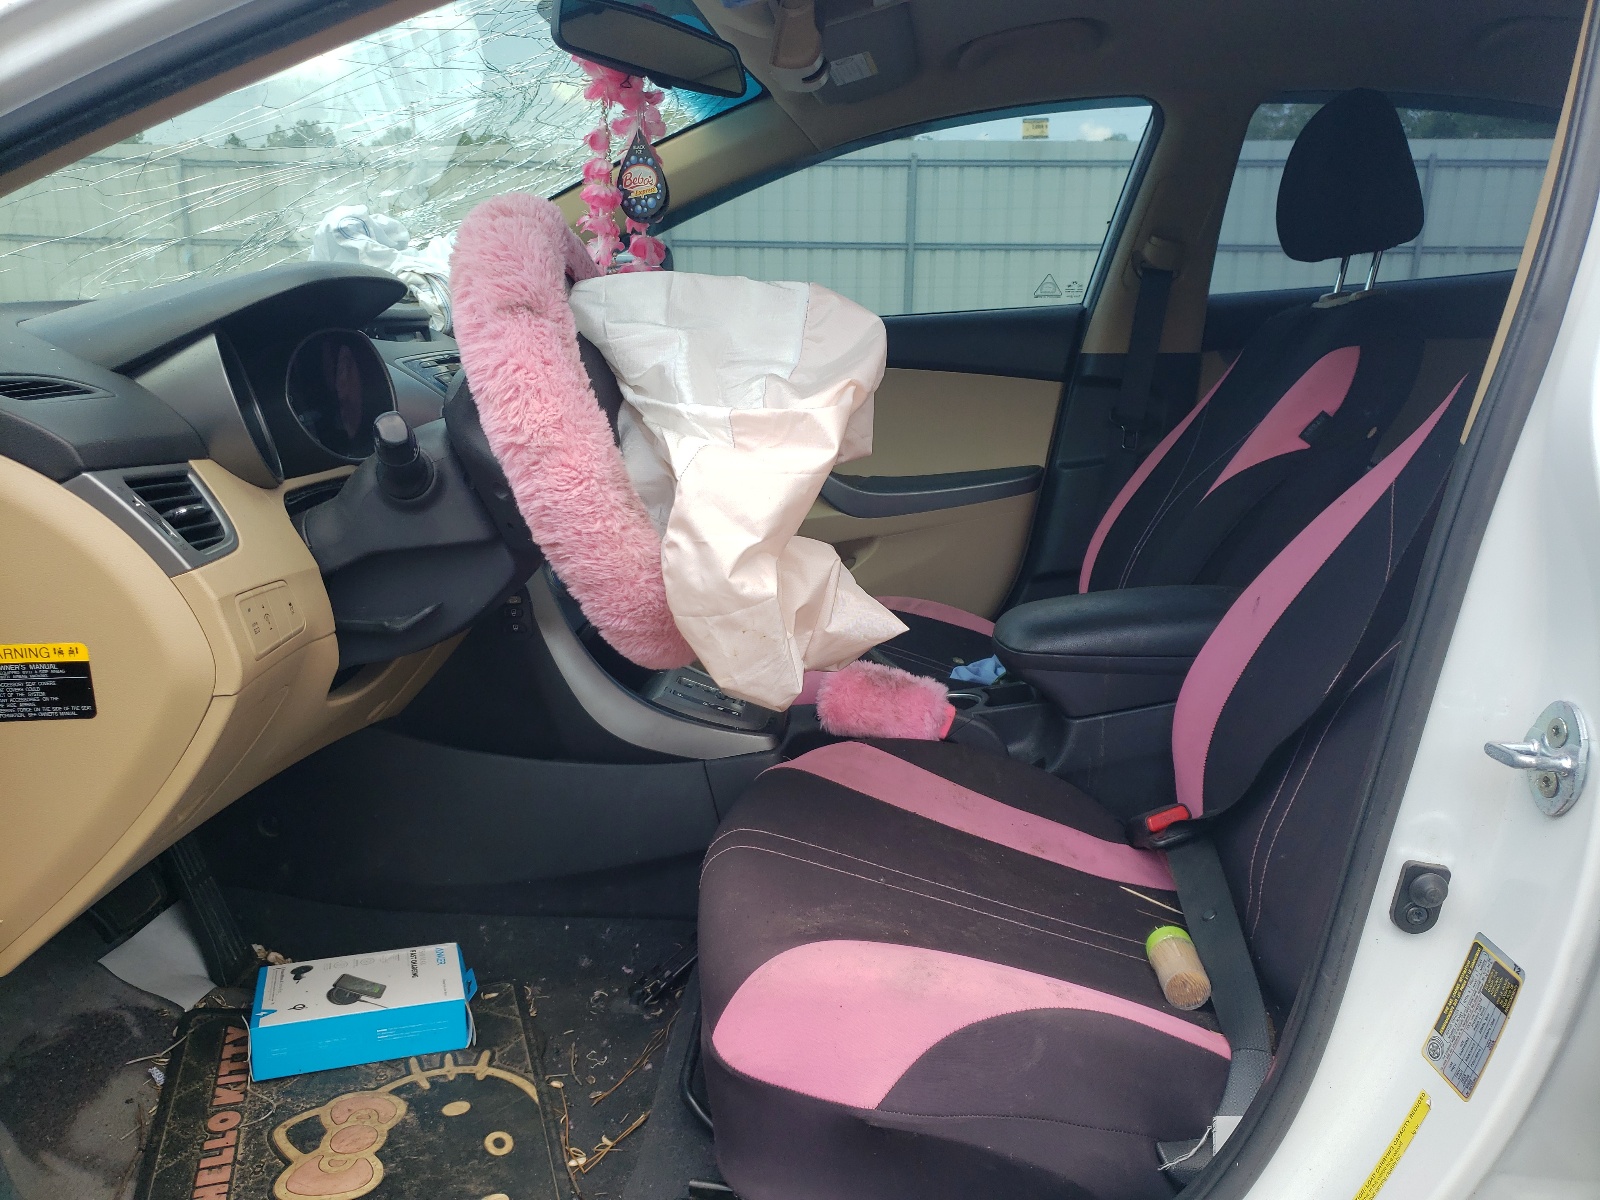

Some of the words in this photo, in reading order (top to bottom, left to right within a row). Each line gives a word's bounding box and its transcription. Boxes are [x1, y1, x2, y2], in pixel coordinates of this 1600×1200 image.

[623, 172, 653, 188] Bebo's
[1513, 963, 1522, 975] T2
[212, 1025, 249, 1107] KITTY
[1365, 1173, 1376, 1189] LOAD
[1393, 1119, 1411, 1146] CAPACITY
[1409, 1092, 1426, 1120] REDUCED
